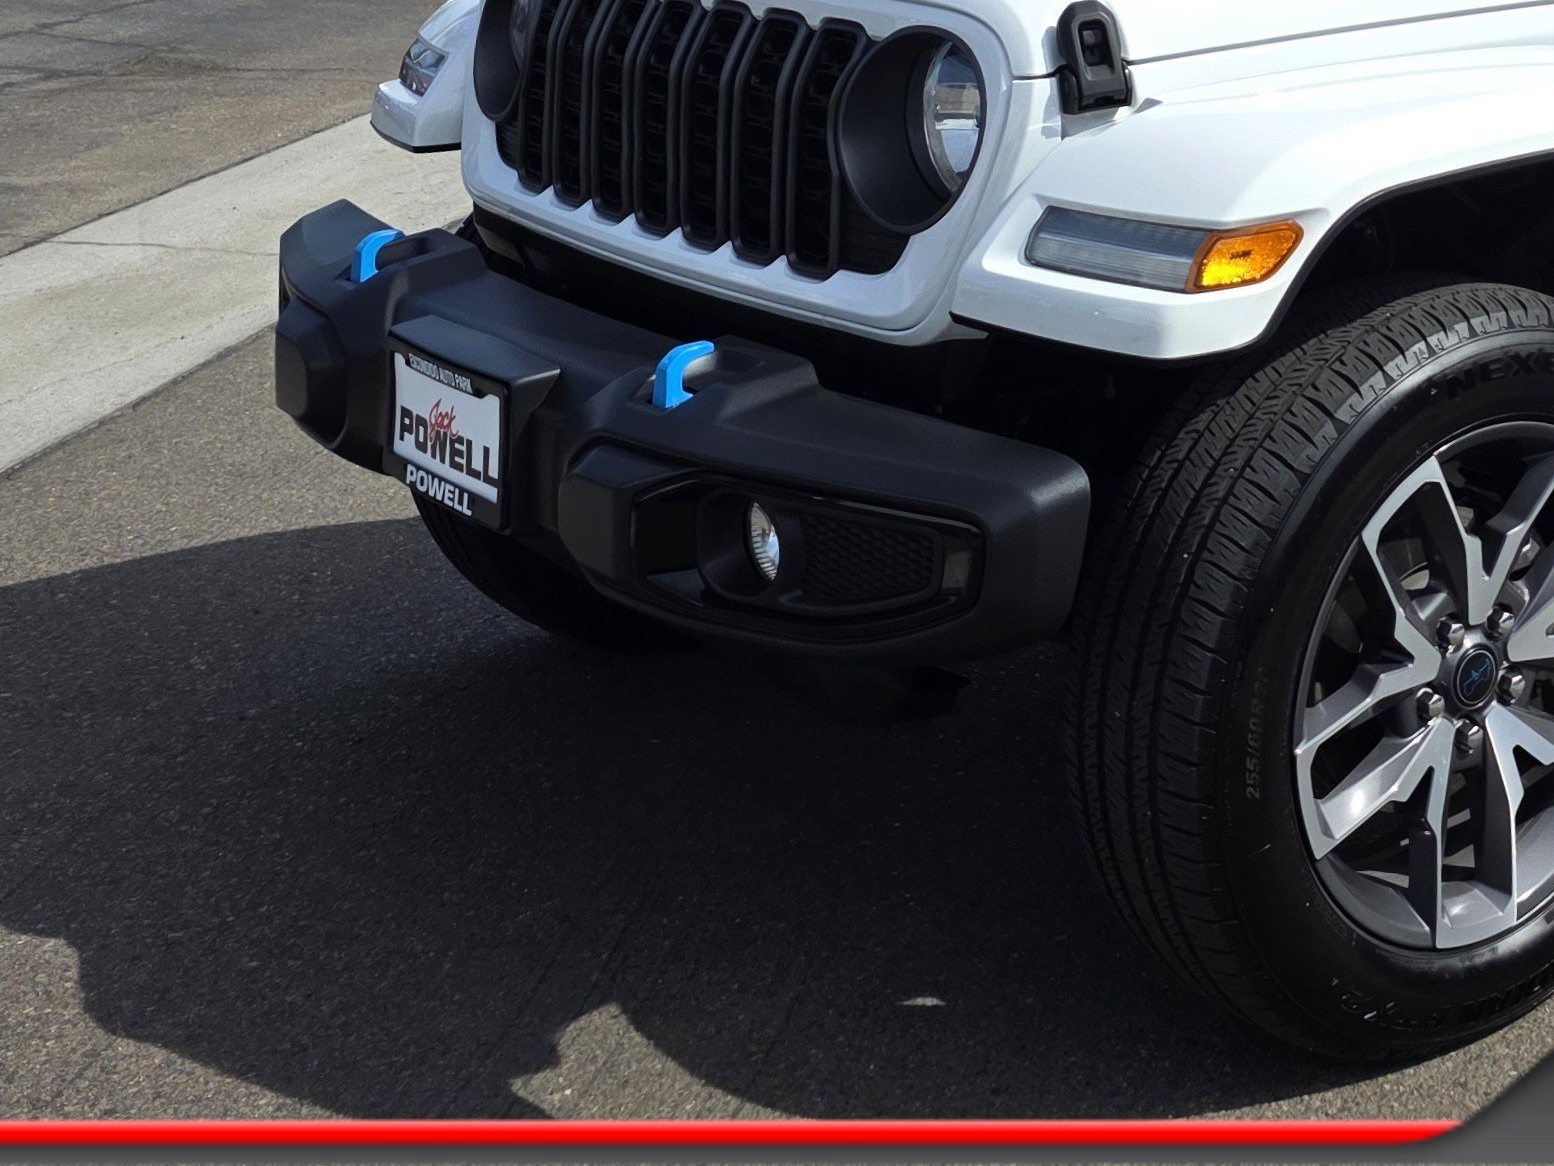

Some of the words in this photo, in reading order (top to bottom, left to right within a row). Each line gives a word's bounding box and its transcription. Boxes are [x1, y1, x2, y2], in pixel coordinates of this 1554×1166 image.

[398, 404, 500, 484] POWELL
[428, 397, 460, 444] Jack
[405, 463, 473, 517] POWELL
